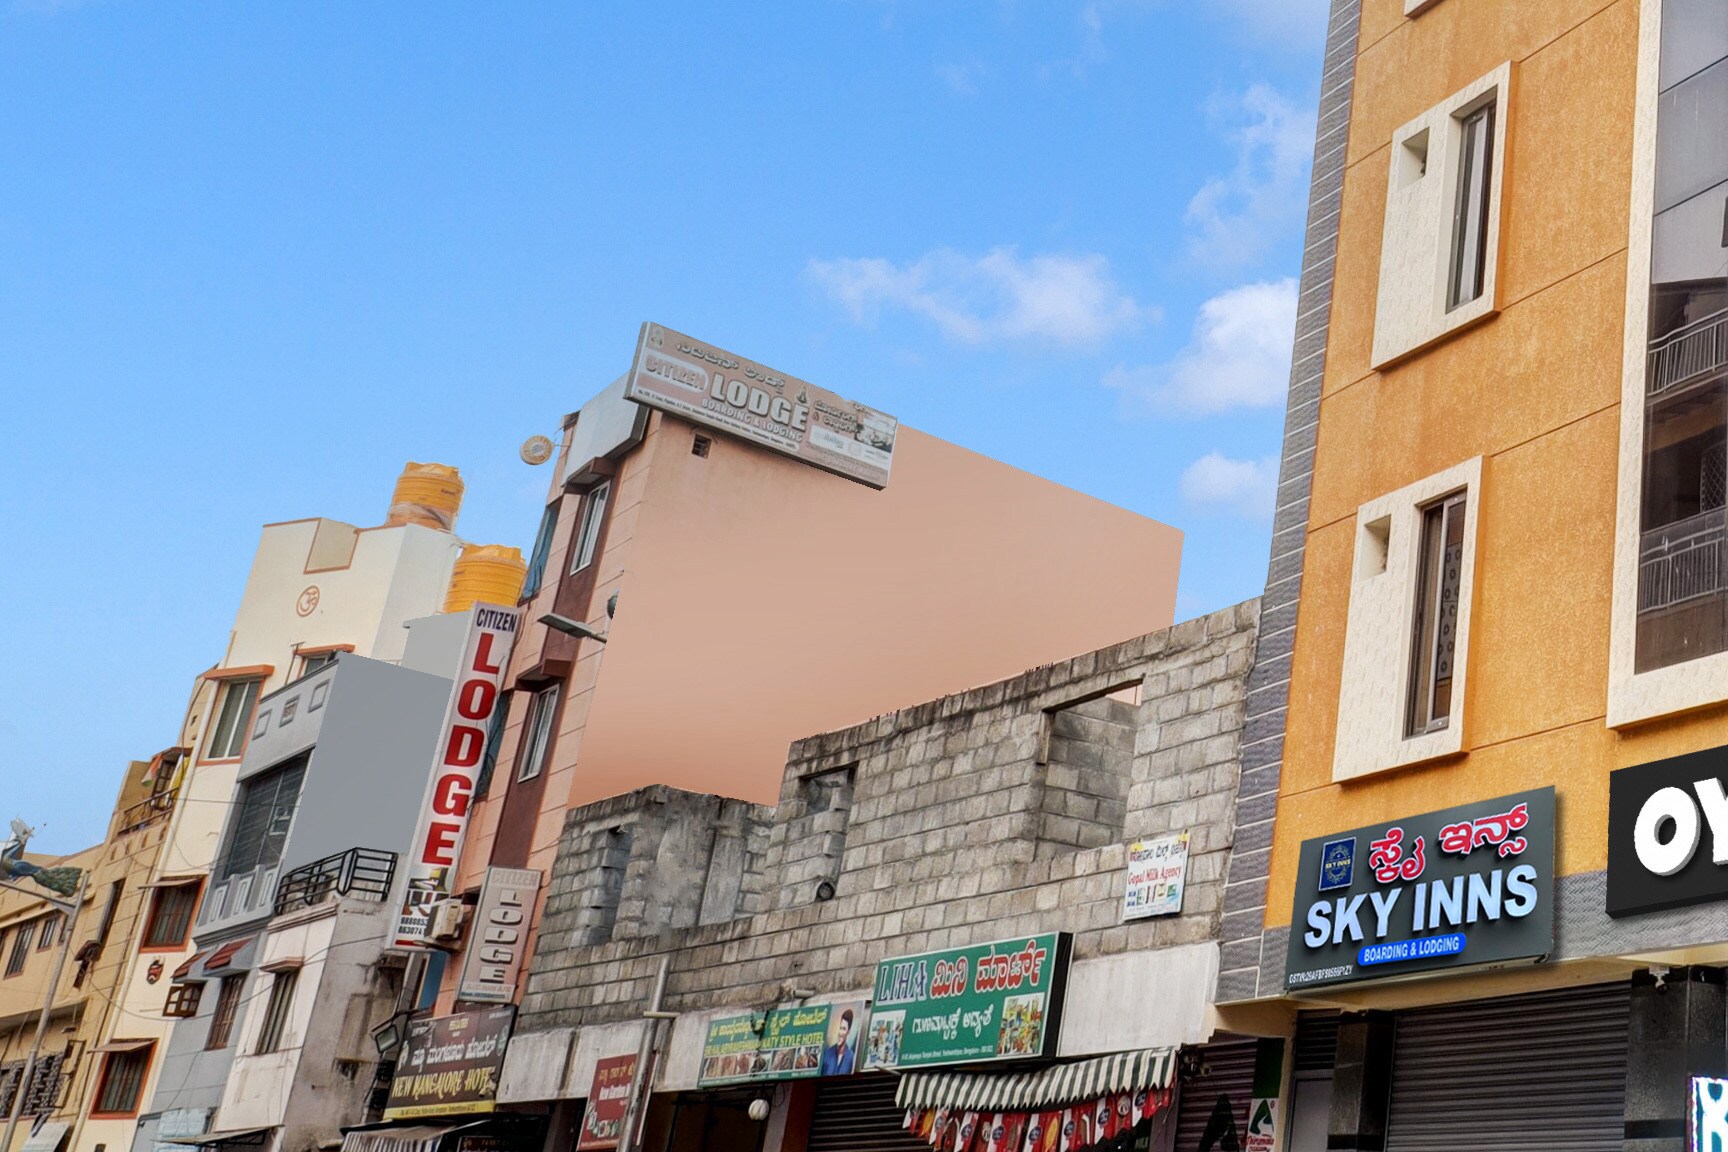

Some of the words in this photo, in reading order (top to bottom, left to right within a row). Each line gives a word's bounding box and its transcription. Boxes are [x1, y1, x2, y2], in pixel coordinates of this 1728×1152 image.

[701, 398, 751, 425] BOARDING
[761, 422, 803, 443] LODGING
[709, 372, 809, 433] LODGE
[476, 608, 518, 633] CITIZEN
[422, 632, 502, 866] LODGE
[1439, 802, 1529, 858] ಇನ್ಸ್
[1304, 888, 1403, 949] SKY
[1411, 864, 1538, 933] INNS
[480, 889, 523, 984] LODGE
[1363, 944, 1408, 963] BOARDING
[1409, 944, 1417, 956] &
[1418, 936, 1460, 955] LODGING
[876, 960, 927, 1006] LIHA
[780, 1033, 802, 1047] STYLE
[801, 1031, 825, 1045] HOTEL
[391, 1075, 414, 1098] NEW
